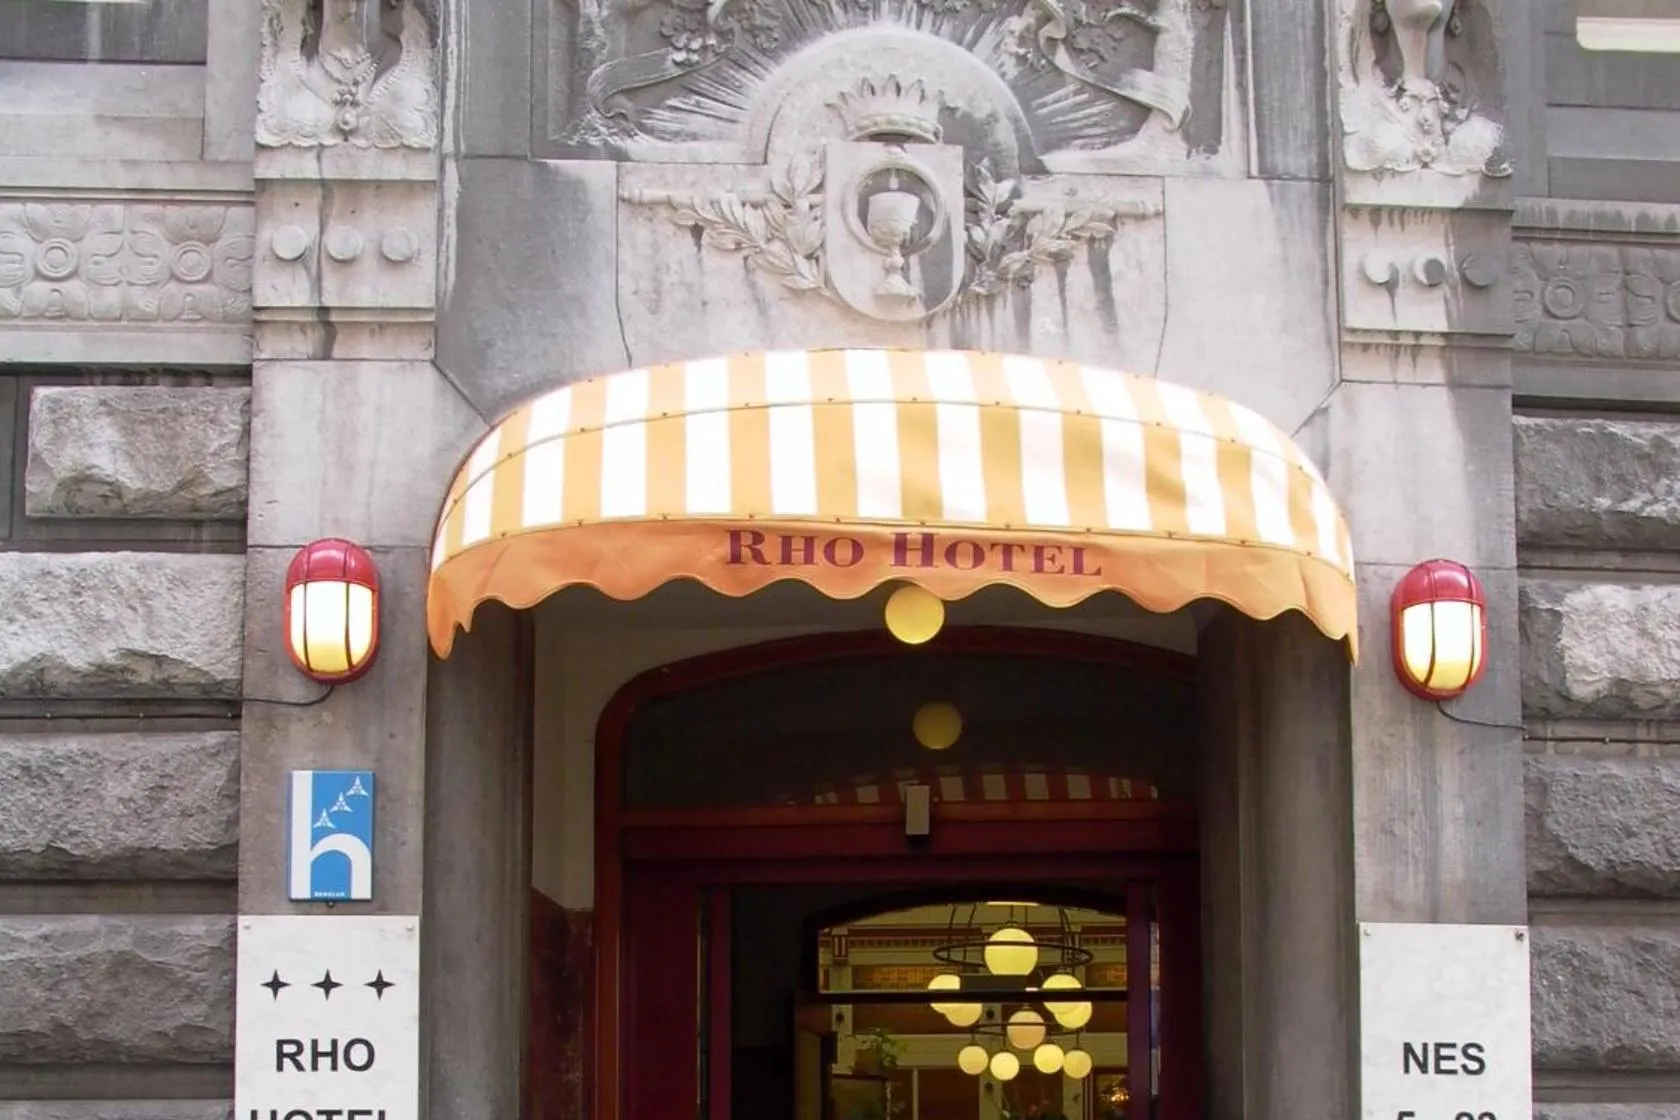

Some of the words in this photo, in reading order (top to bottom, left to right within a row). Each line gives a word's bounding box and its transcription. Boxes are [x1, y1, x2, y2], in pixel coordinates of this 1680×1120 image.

[725, 529, 865, 568] RHO
[889, 532, 1102, 577] HOTEL
[275, 1037, 375, 1073] RHO
[1403, 1041, 1486, 1076] NES
